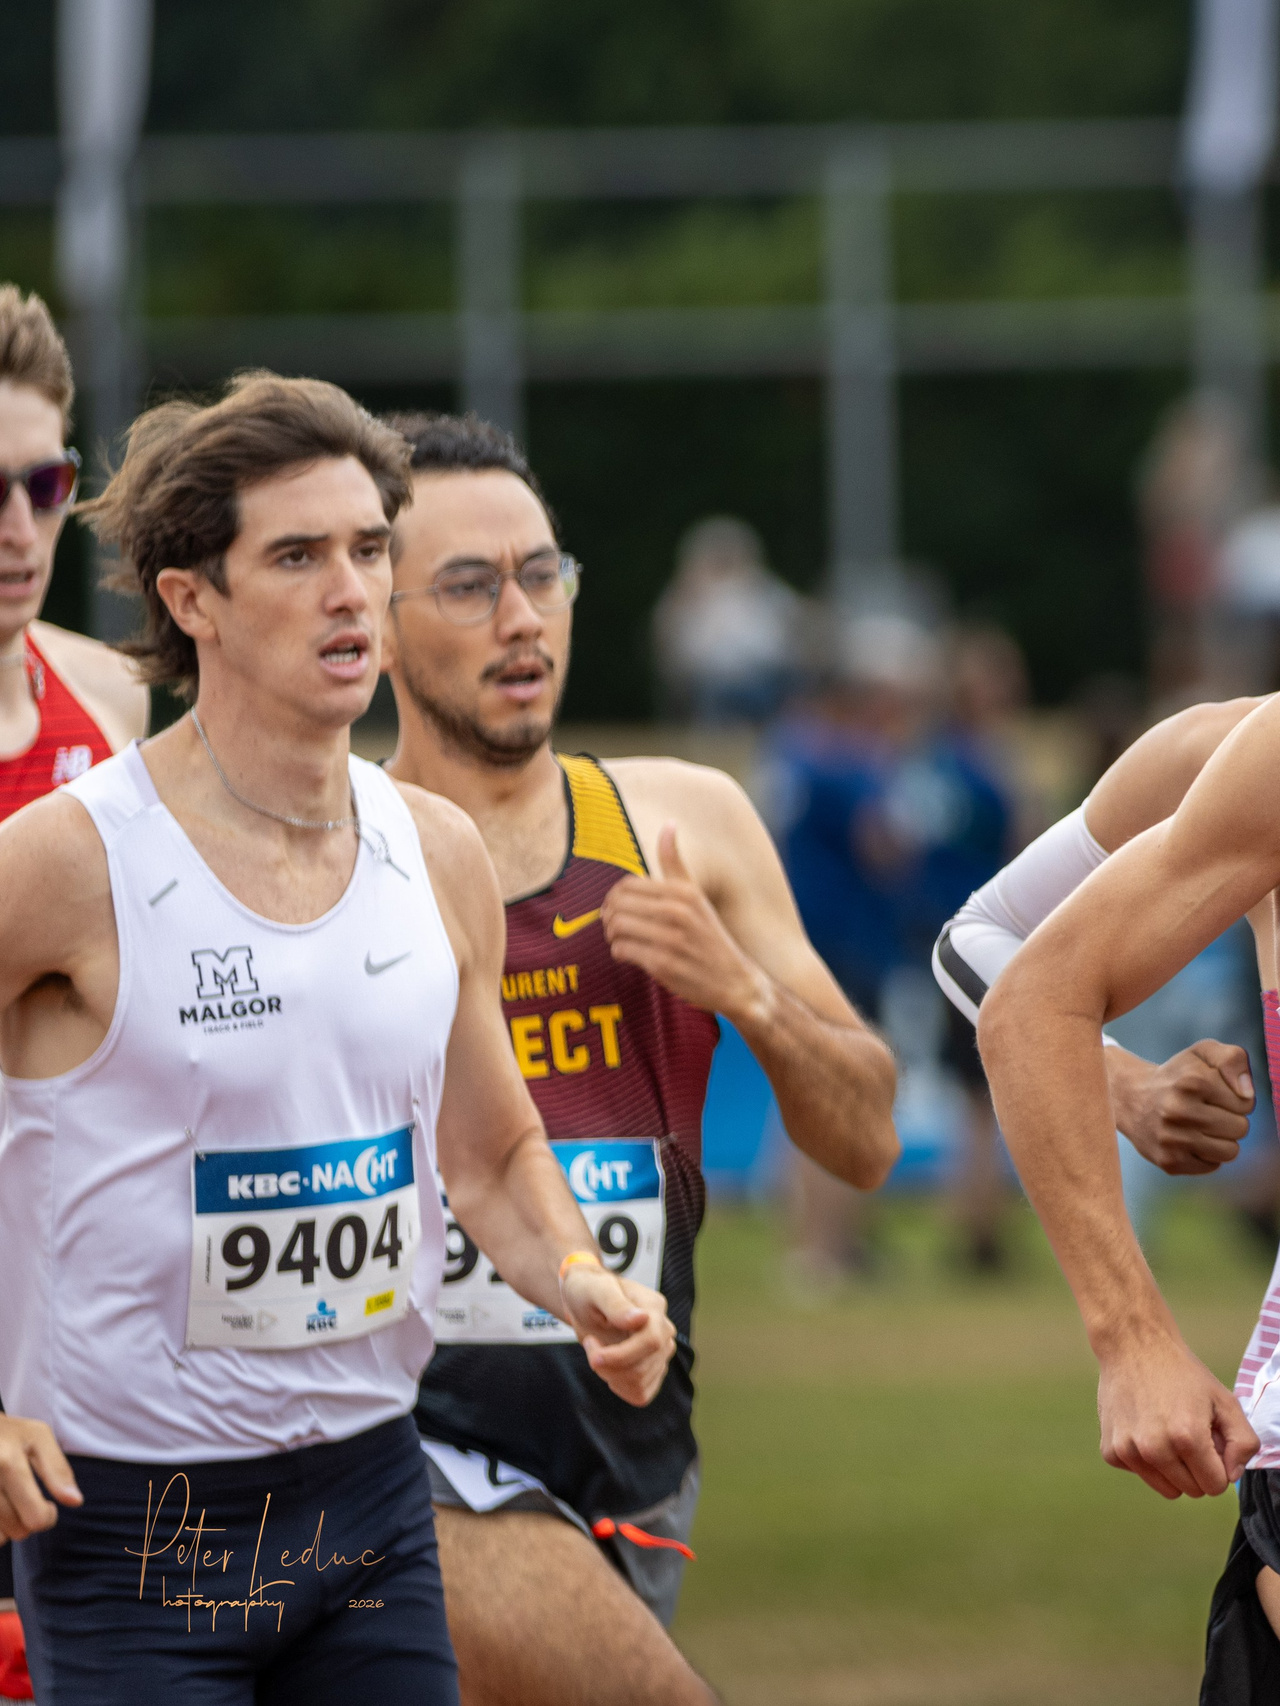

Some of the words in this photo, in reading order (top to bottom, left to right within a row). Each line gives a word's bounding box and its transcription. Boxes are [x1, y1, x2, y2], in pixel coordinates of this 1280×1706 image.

[179, 994, 283, 1026] MALGOR
[501, 964, 580, 1001] URENT
[510, 1004, 623, 1079] ECT
[221, 1203, 404, 1292] 9404
